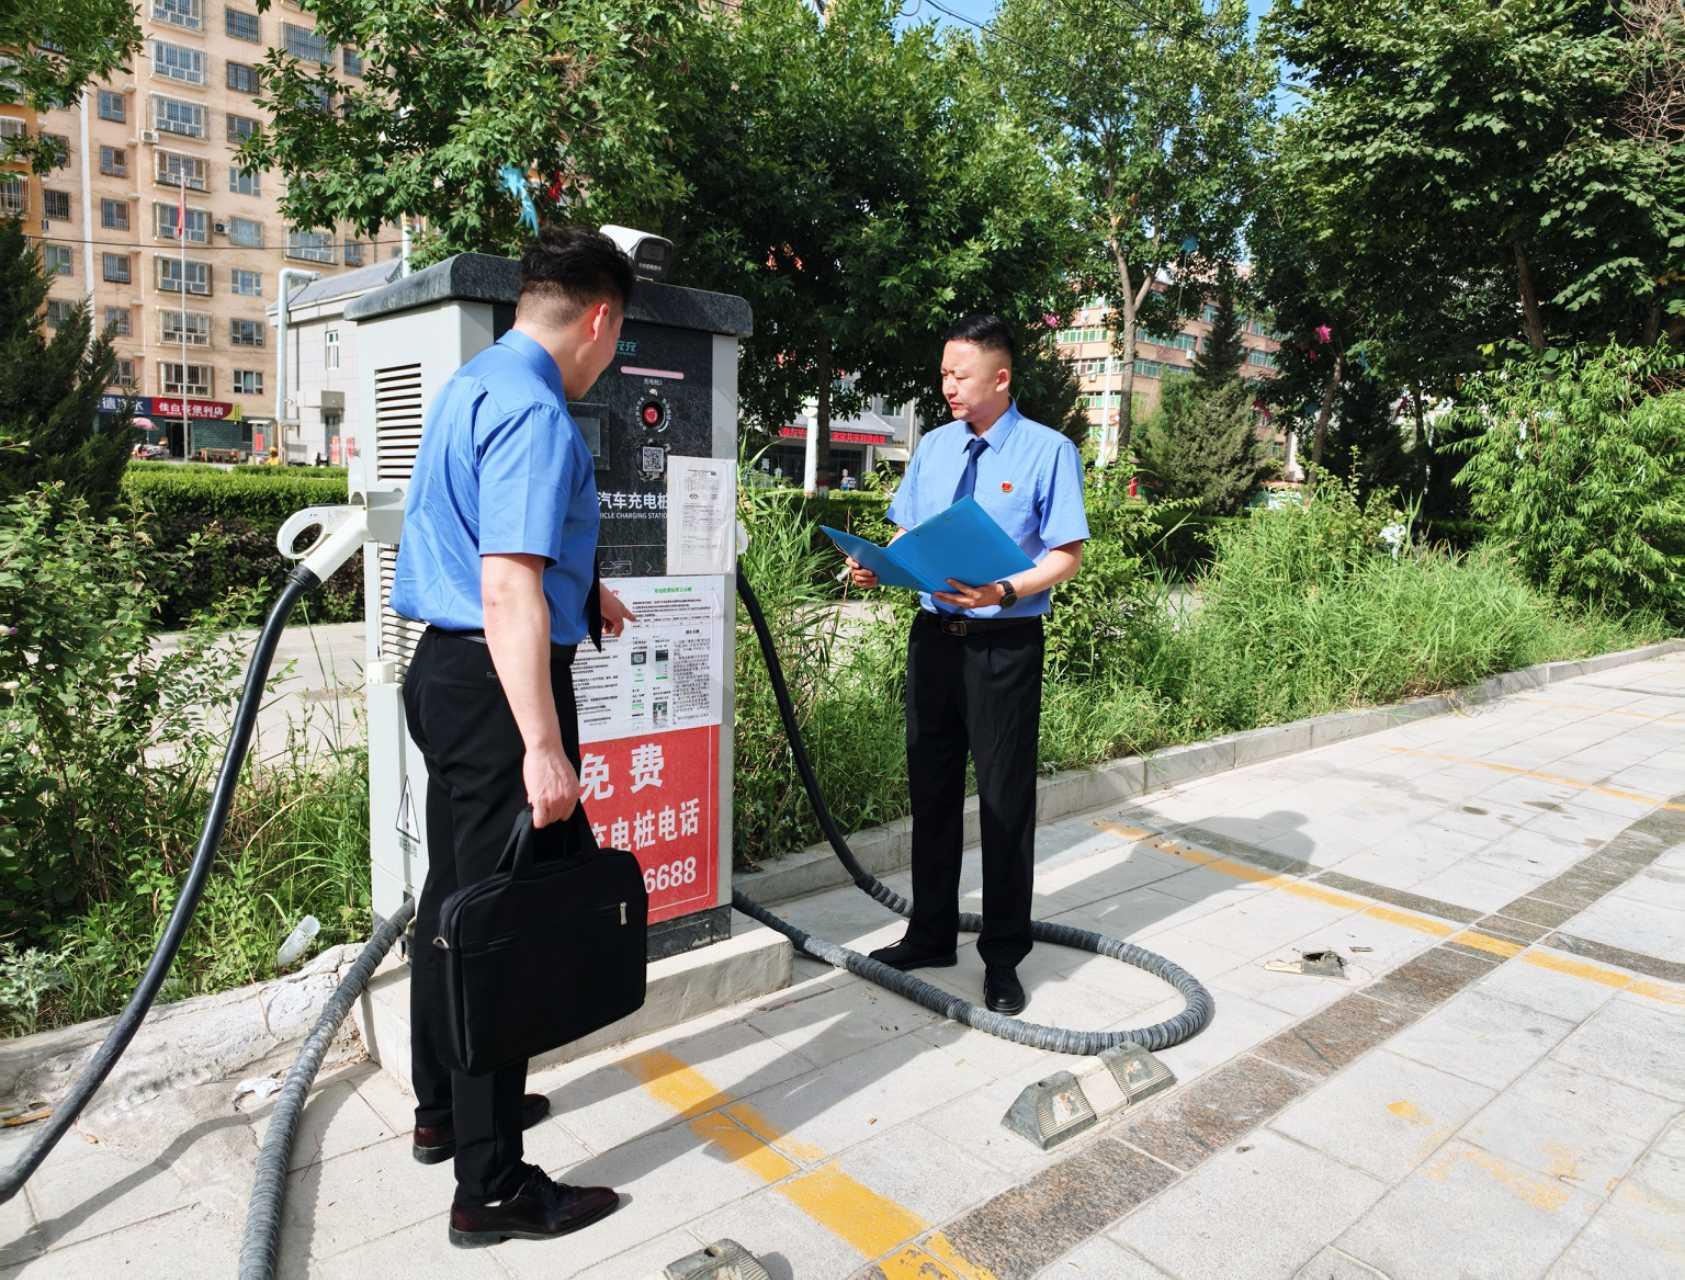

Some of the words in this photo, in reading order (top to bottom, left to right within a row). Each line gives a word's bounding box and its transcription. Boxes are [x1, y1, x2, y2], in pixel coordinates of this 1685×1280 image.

[597, 491, 667, 509] 汽车充电桩
[616, 512, 647, 521] CHARGING
[579, 743, 665, 804] 免费
[643, 856, 697, 894] 6688
